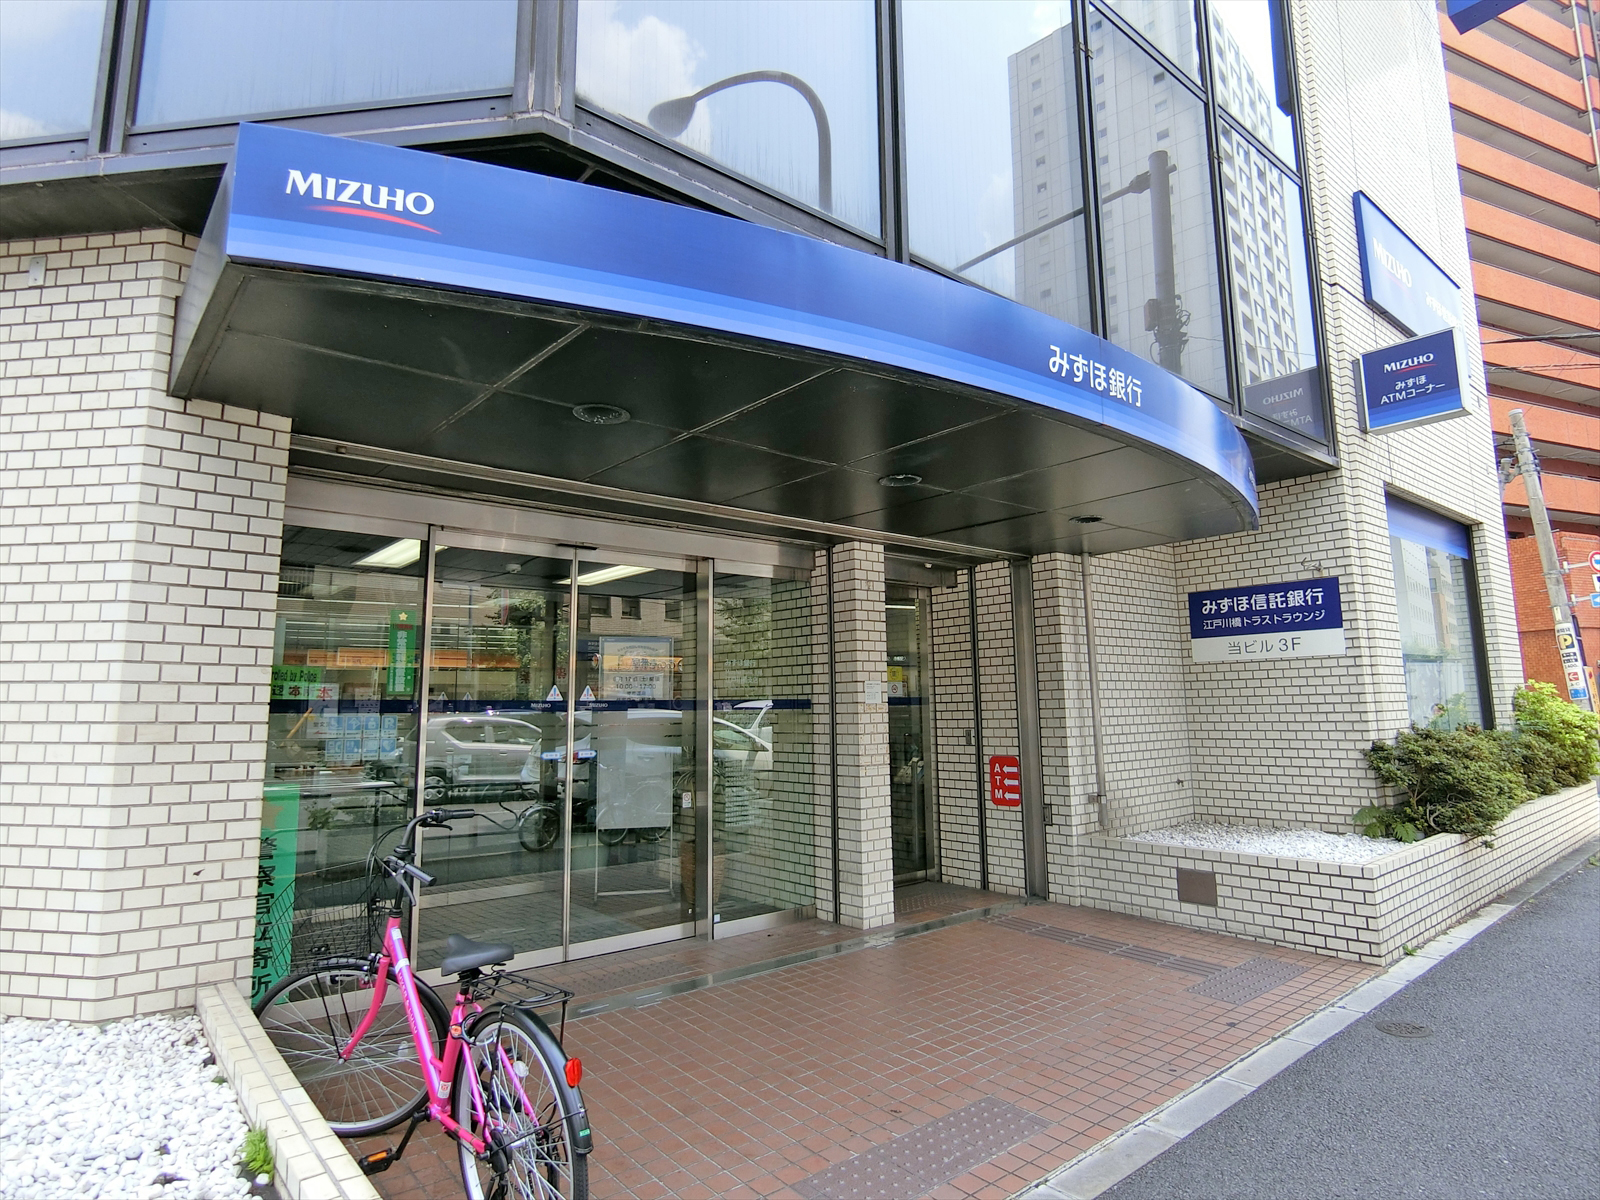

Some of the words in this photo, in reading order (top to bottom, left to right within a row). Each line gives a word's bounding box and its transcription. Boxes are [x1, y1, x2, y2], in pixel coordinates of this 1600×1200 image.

[286, 169, 434, 215] MIZUHO
[1372, 237, 1412, 287] MIZUHO
[1384, 353, 1434, 374] MIZUHO
[1049, 345, 1142, 407] みずほ銀行
[1395, 375, 1427, 390] みずほ
[1380, 382, 1445, 405] ATMコーナー
[1202, 588, 1324, 615] みずほ信託銀行
[1203, 609, 1325, 630] 江戸川橋トラストラウンジ
[1228, 640, 1273, 655] 当ビル
[1278, 637, 1301, 652] 3F
